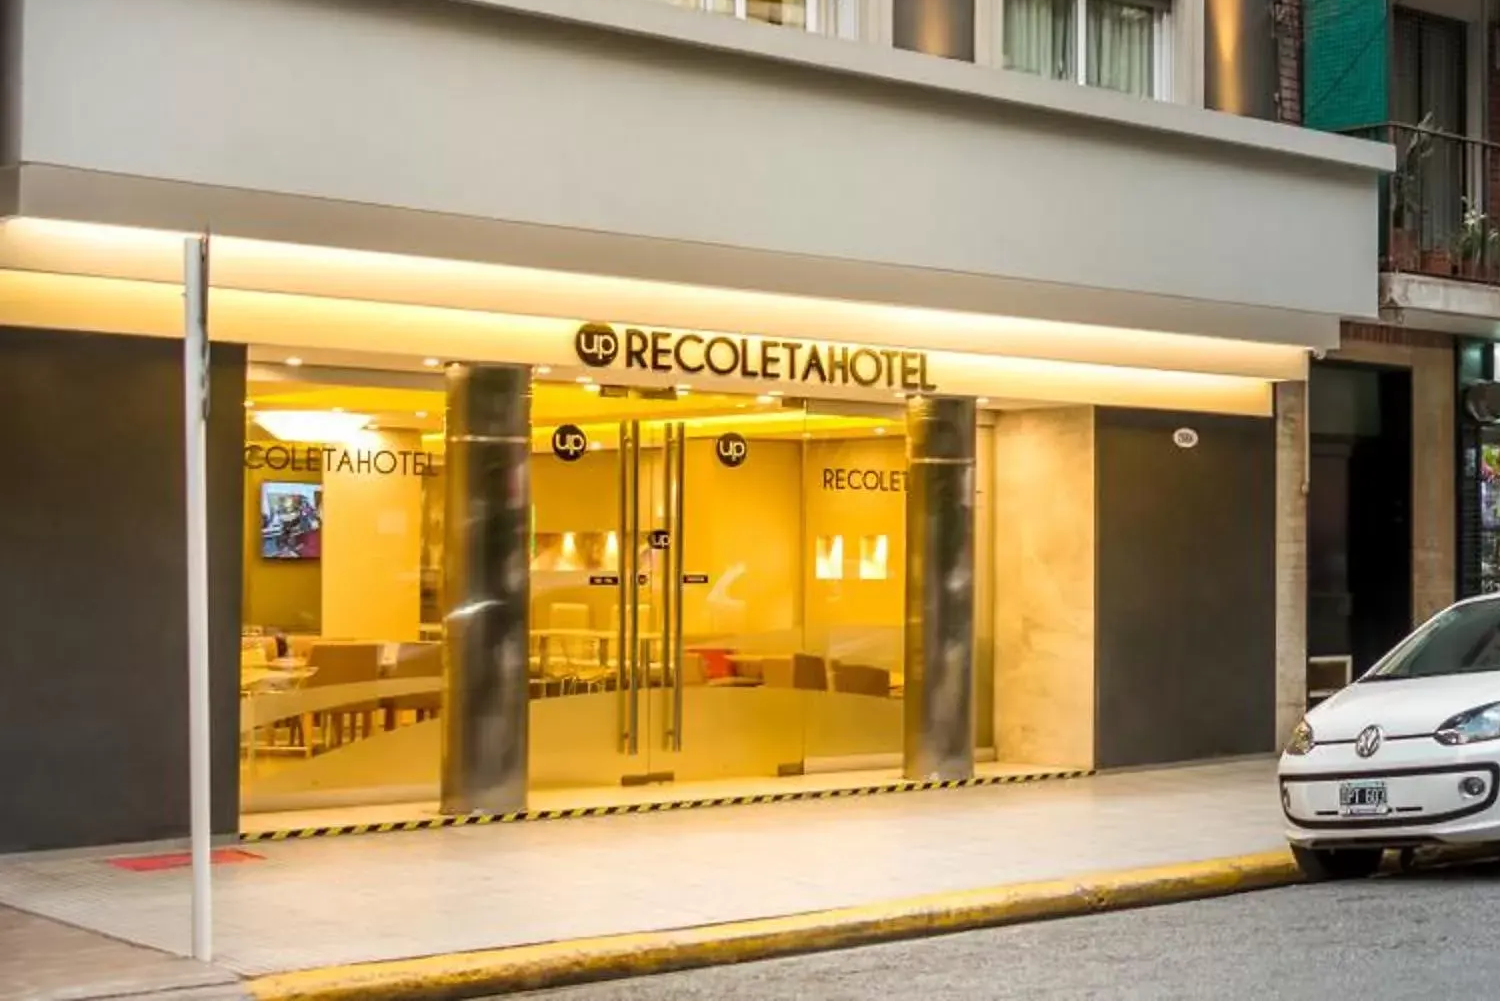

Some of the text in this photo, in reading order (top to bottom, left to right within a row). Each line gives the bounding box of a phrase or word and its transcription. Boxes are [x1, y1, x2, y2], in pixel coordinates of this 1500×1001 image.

[579, 328, 937, 390] up RECOLETAHOTEL
[555, 433, 585, 456] up
[718, 441, 746, 461] up
